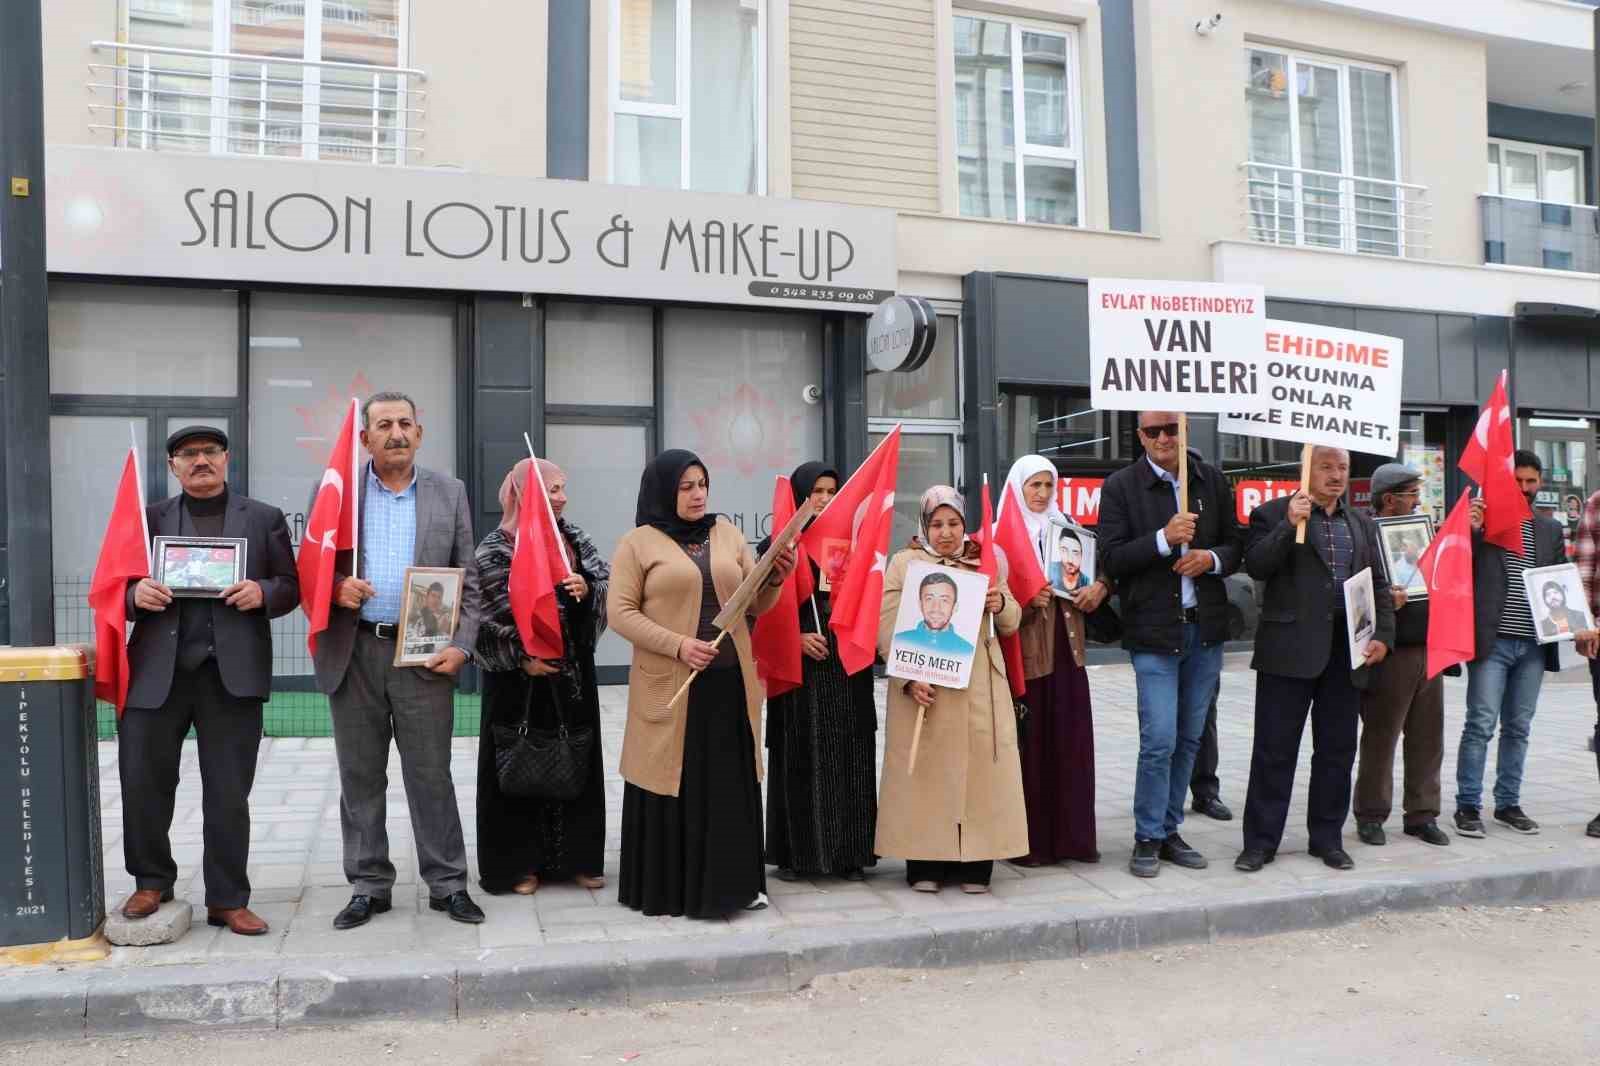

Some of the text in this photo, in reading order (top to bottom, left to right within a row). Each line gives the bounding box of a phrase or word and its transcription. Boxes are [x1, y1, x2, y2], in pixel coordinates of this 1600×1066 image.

[181, 188, 855, 282] SALON LOTUS & MAKE-UP
[811, 289, 834, 300] 235
[838, 291, 854, 301] 09
[858, 290, 874, 300] 08
[1102, 293, 1145, 310] EVLAT
[1144, 318, 1211, 353] VAN
[1271, 386, 1352, 411] ONLAR
[1290, 411, 1391, 441] EMANET.
[928, 656, 962, 673] MERT
[16, 904, 46, 916] 2021
